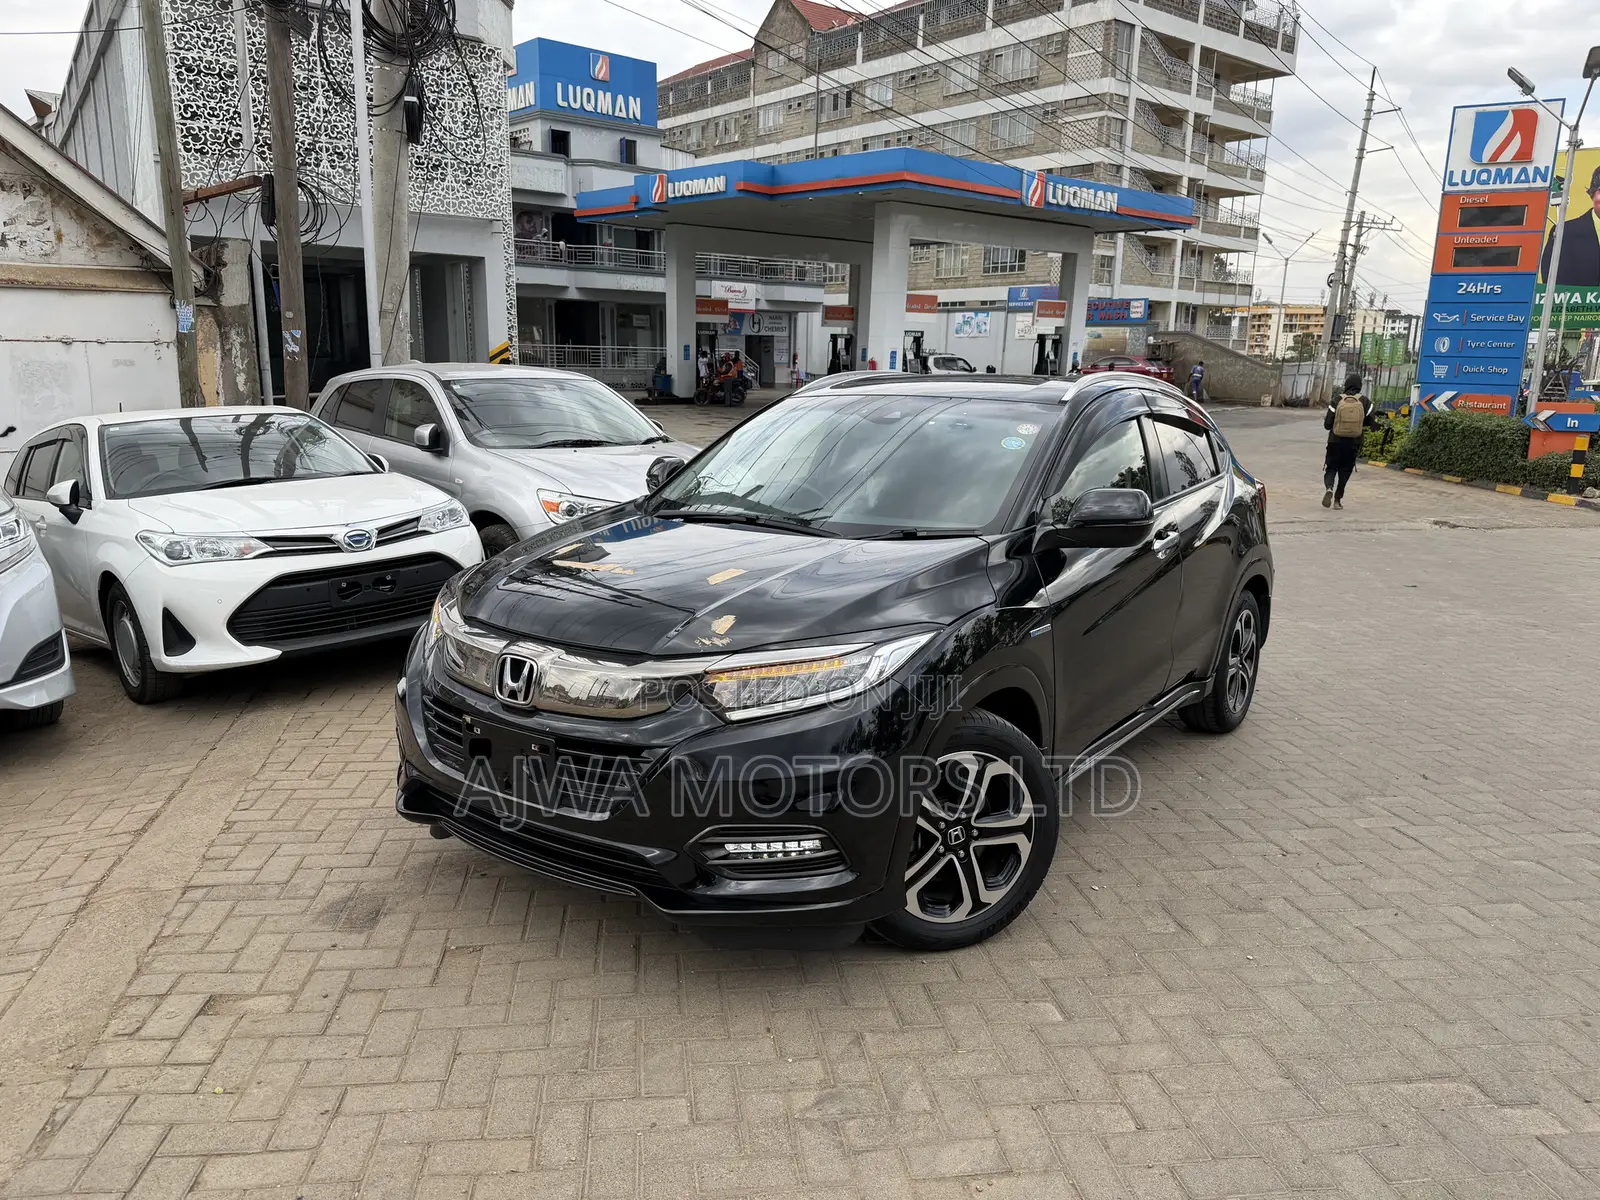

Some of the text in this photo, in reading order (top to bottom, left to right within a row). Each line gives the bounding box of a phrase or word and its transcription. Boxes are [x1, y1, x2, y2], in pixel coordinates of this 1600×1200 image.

[556, 82, 641, 121] LUQMAN
[1447, 165, 1550, 187] LUQMAN
[668, 175, 726, 198] LUQMAN
[1046, 181, 1118, 213] LUQMAN
[1459, 195, 1489, 204] Diesel
[1453, 235, 1499, 244] Unleaded
[1457, 282, 1502, 294] 24Hrs
[1586, 292, 1600, 304] K
[1098, 312, 1128, 321] WASH
[1470, 314, 1505, 323] Service
[1507, 314, 1525, 324] Bay
[764, 325, 787, 333] CHEMIST
[1466, 339, 1515, 350] Tyre Center
[1462, 365, 1508, 375] Quick Shop
[1457, 400, 1507, 411] Restaurant
[1566, 417, 1580, 428] In
